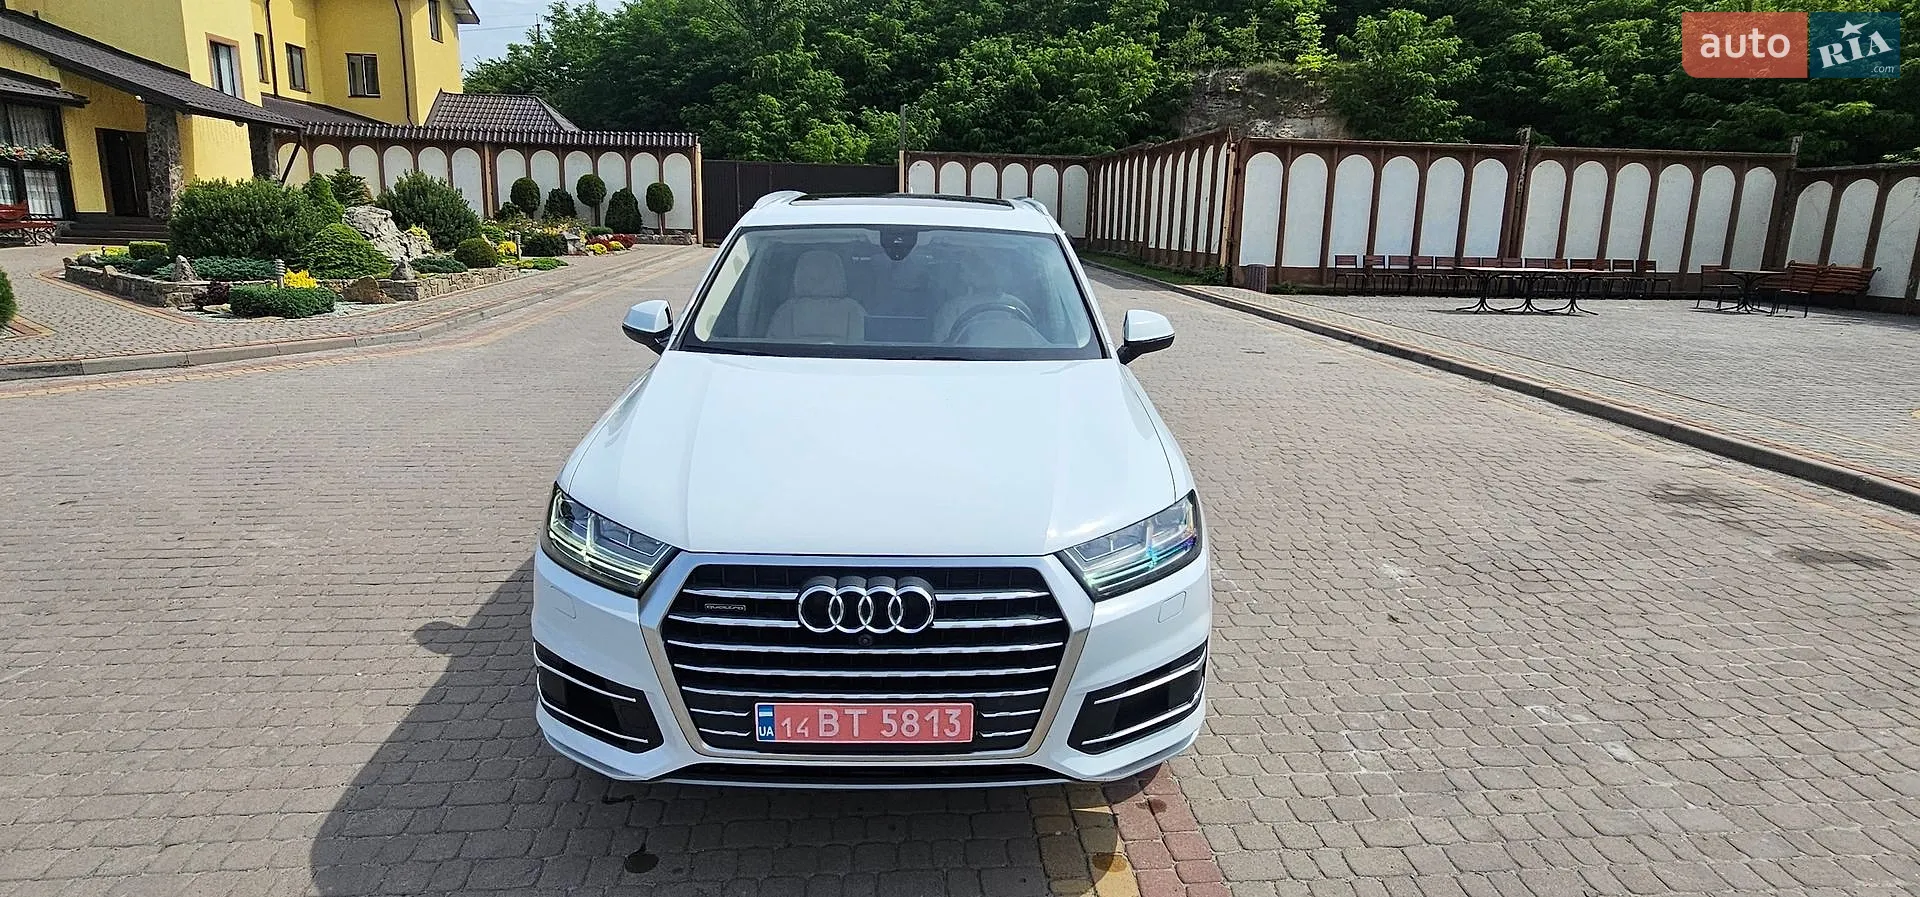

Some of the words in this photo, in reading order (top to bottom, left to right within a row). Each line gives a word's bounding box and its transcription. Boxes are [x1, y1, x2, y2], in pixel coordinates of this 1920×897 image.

[759, 726, 774, 736] UA
[781, 717, 809, 738] 14
[818, 708, 867, 737] BT
[880, 708, 962, 737] 5813
